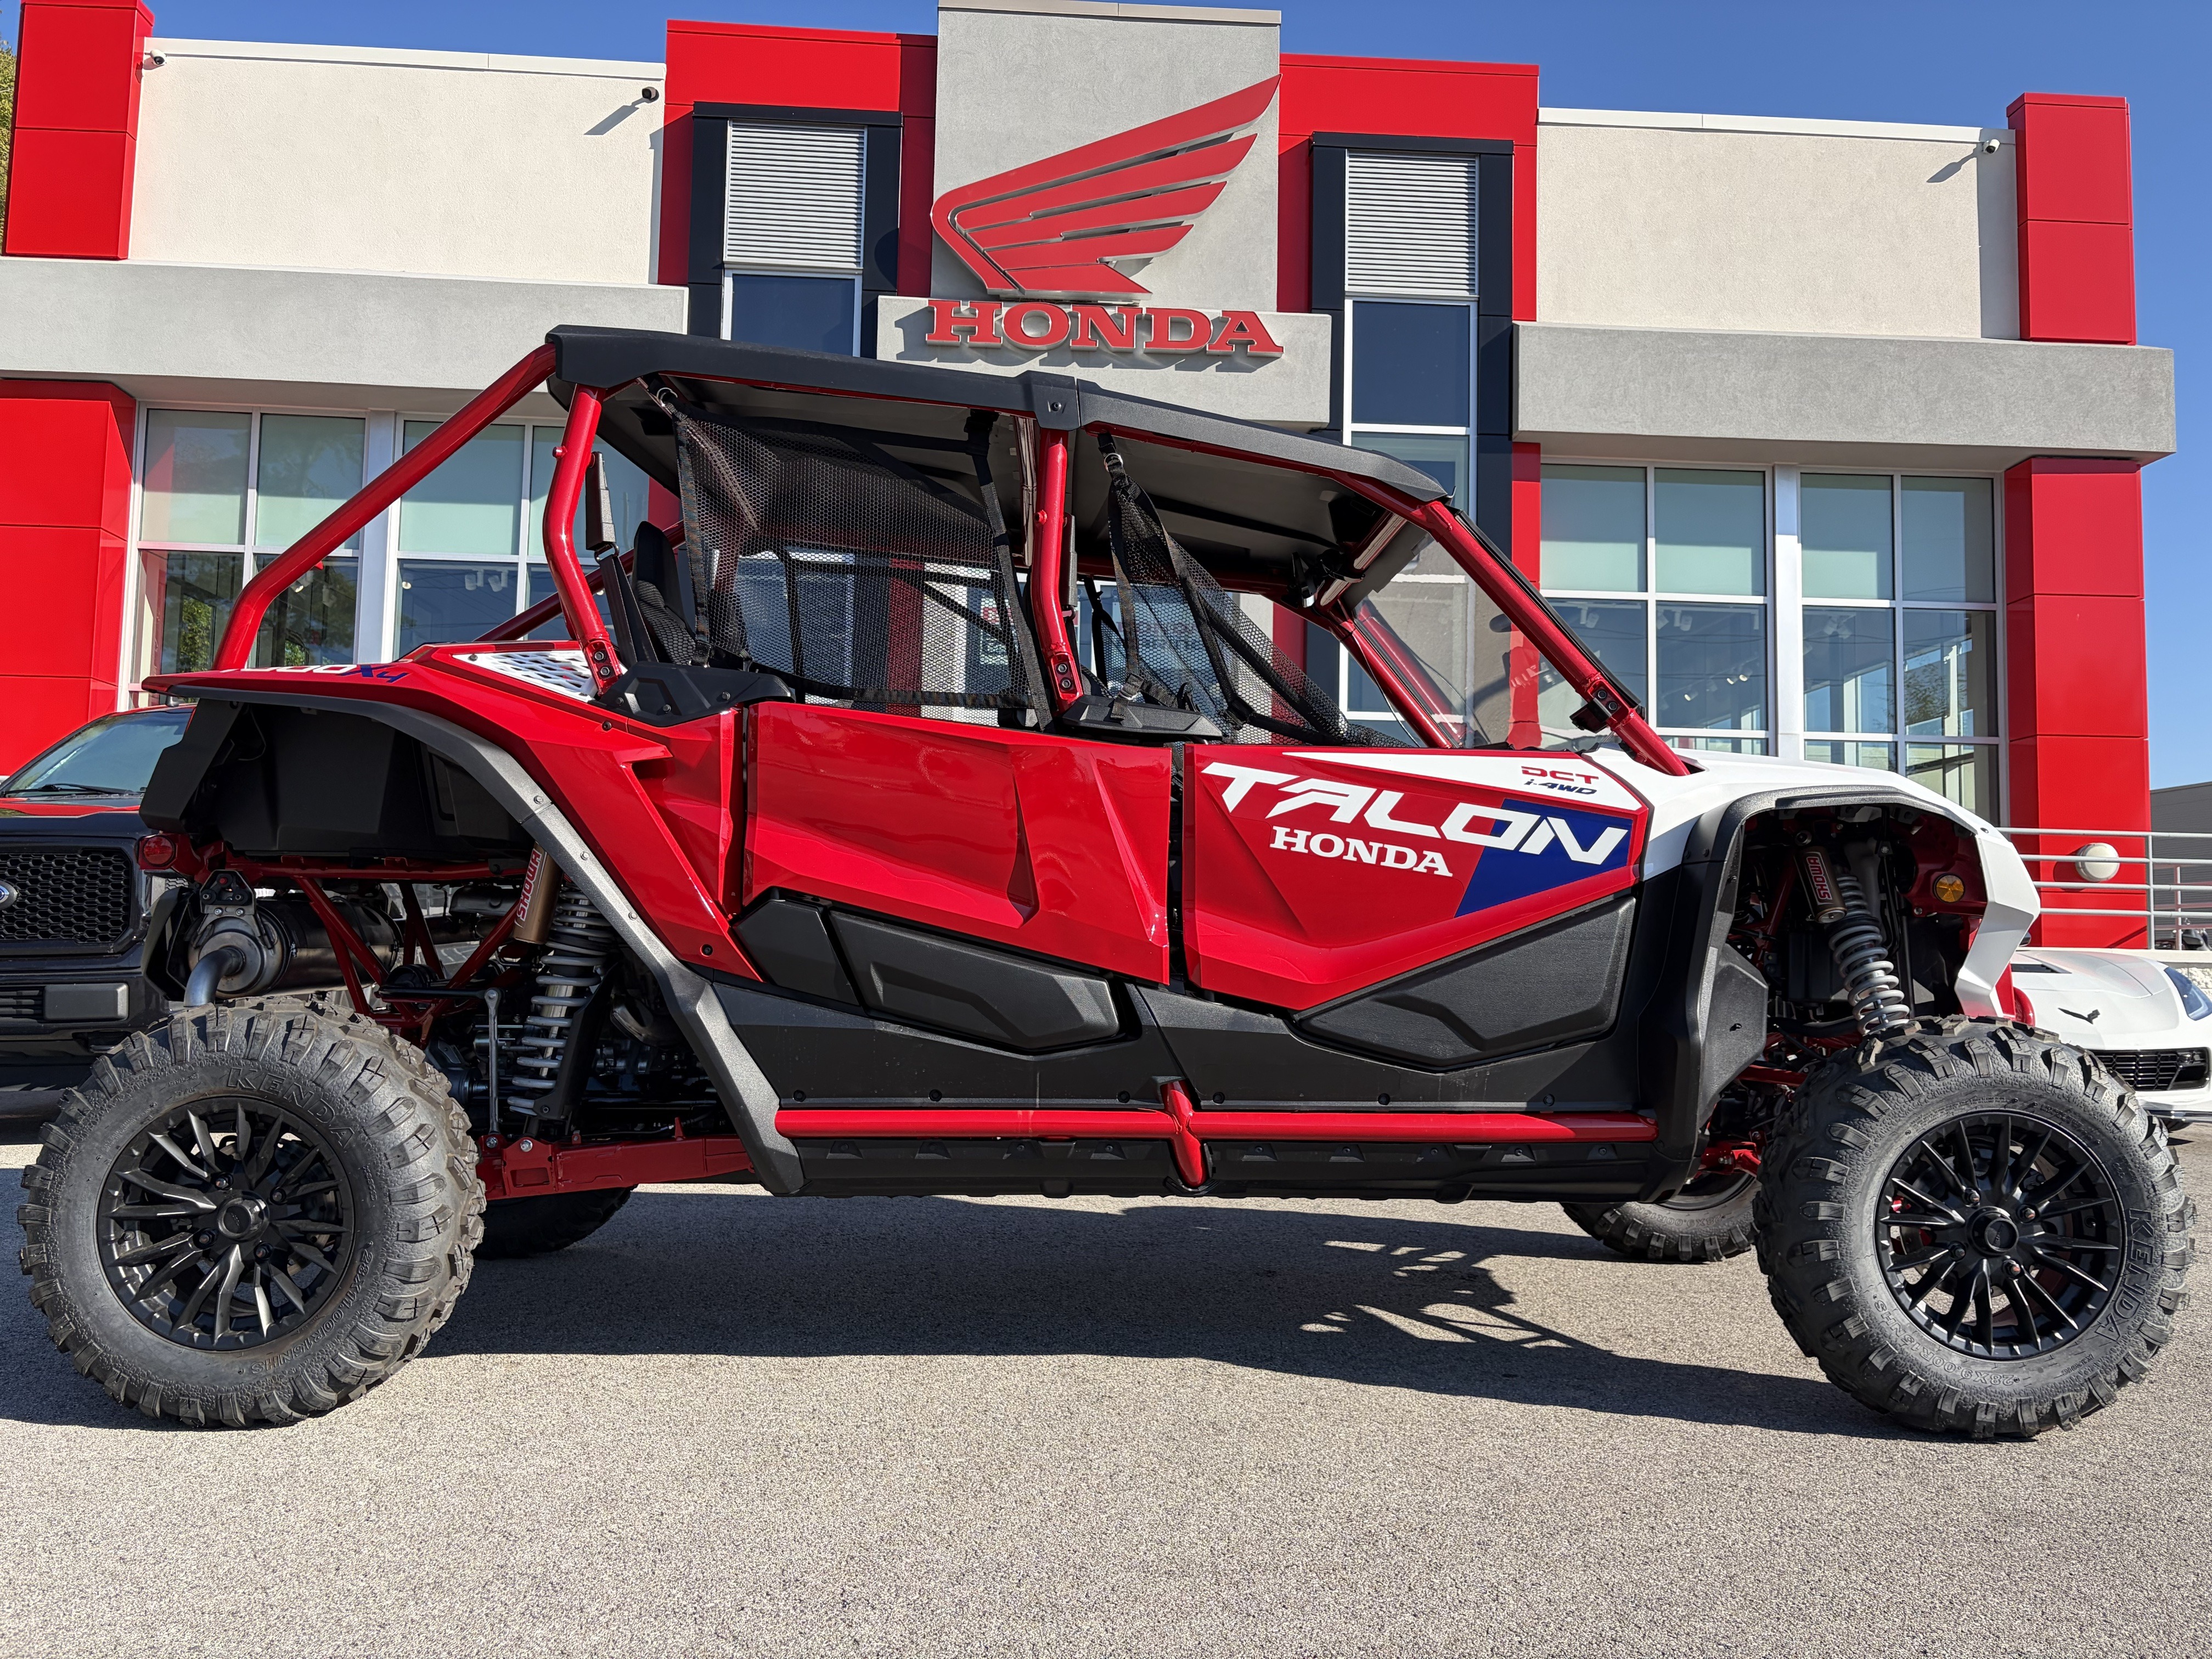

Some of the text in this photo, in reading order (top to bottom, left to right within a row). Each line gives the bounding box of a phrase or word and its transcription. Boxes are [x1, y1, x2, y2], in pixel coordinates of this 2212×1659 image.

[926, 300, 1284, 357] HONDA
[220, 665, 409, 683] 000X4
[1521, 766, 1599, 784] DCT
[1524, 779, 1597, 795] i-4WD
[1201, 762, 1629, 865] TALON
[1269, 826, 1453, 877] HONDA
[1806, 857, 1832, 900] SHOWA
[517, 848, 542, 922] SHOWA
[227, 1067, 354, 1149] KENDA
[2095, 1208, 2154, 1342] KENDA
